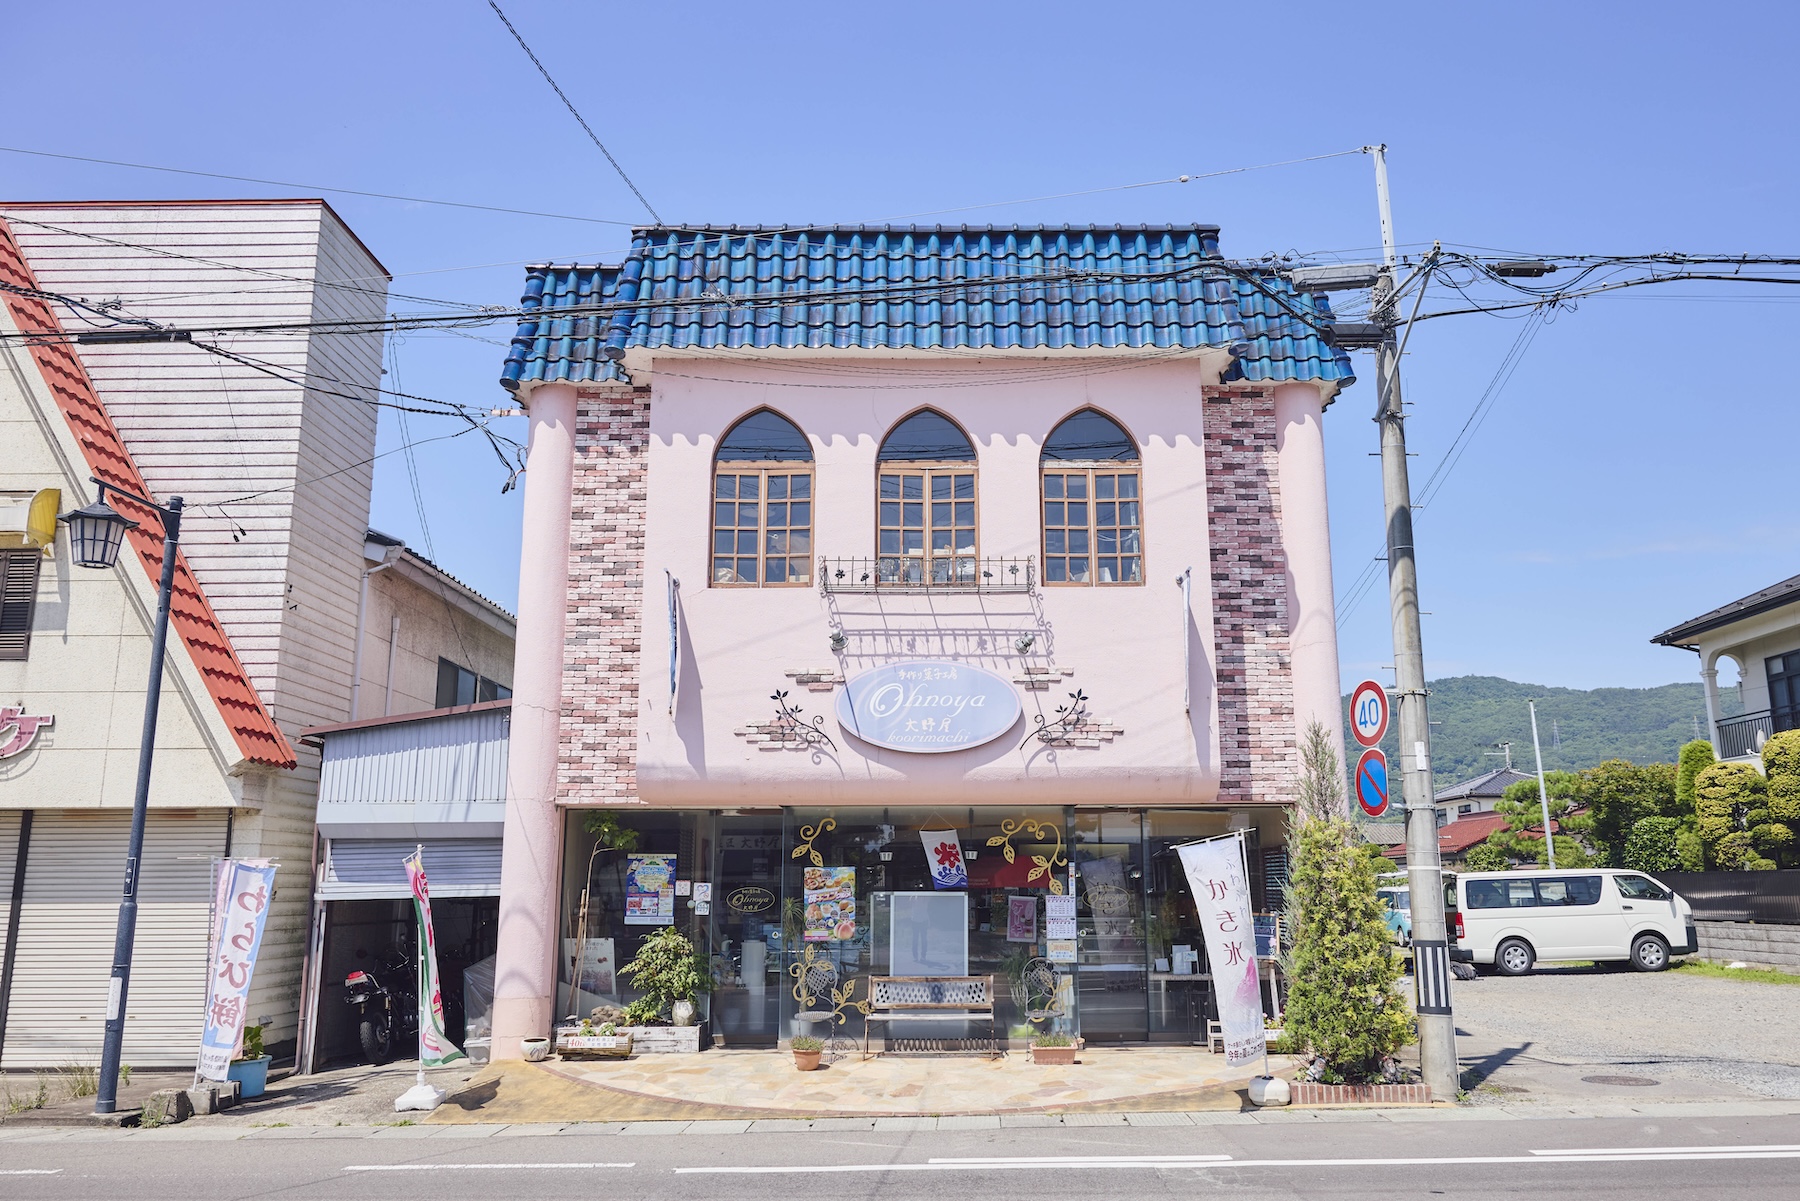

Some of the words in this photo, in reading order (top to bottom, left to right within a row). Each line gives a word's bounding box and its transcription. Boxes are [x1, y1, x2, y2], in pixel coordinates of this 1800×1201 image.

[898, 667, 957, 681] 手作り菓子工房
[869, 682, 986, 717] Ohnoya
[1360, 698, 1379, 728] 40
[887, 728, 971, 743] koorimachi
[905, 717, 952, 732] 大野屋
[934, 841, 960, 868] 氷
[1205, 879, 1245, 966] かき氷
